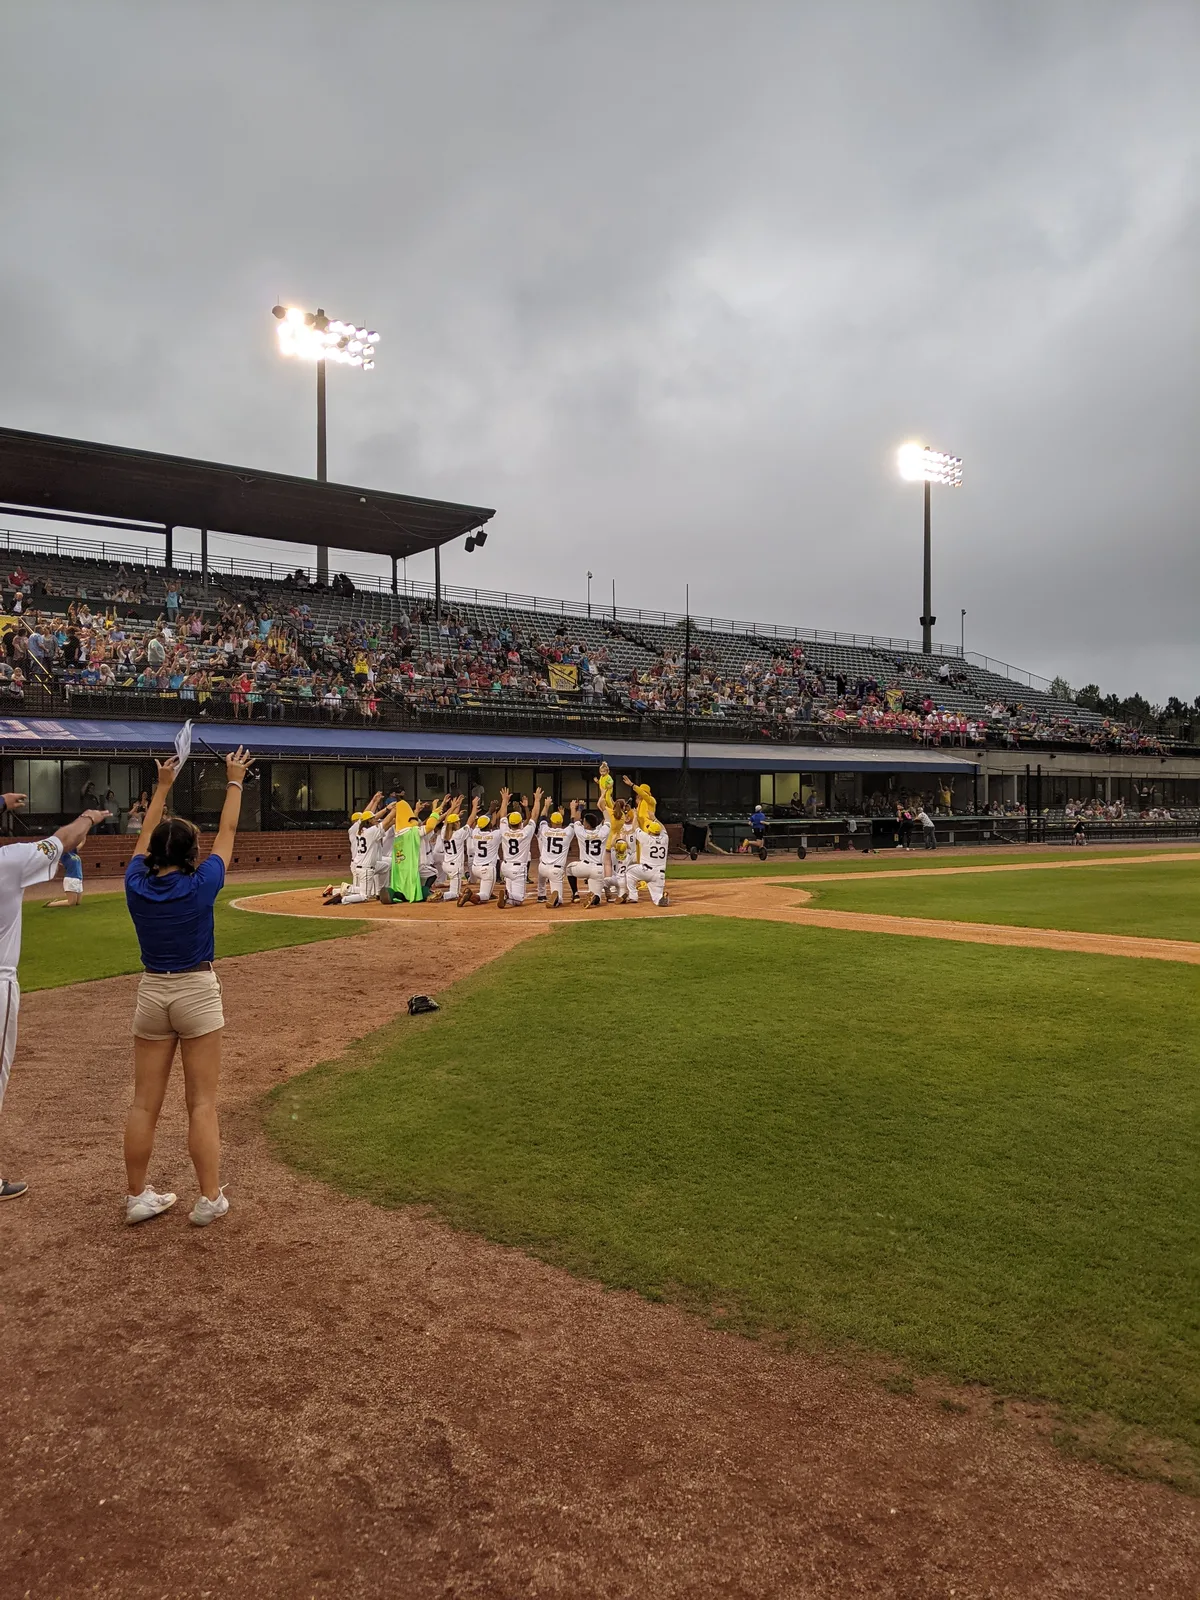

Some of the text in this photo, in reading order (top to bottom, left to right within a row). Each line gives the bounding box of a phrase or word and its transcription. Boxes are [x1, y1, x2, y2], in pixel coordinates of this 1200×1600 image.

[444, 839, 457, 854] 21
[477, 841, 488, 858] 5
[508, 838, 520, 855] 8
[546, 836, 563, 855] 15
[584, 839, 602, 856] 13
[649, 845, 666, 859] 23
